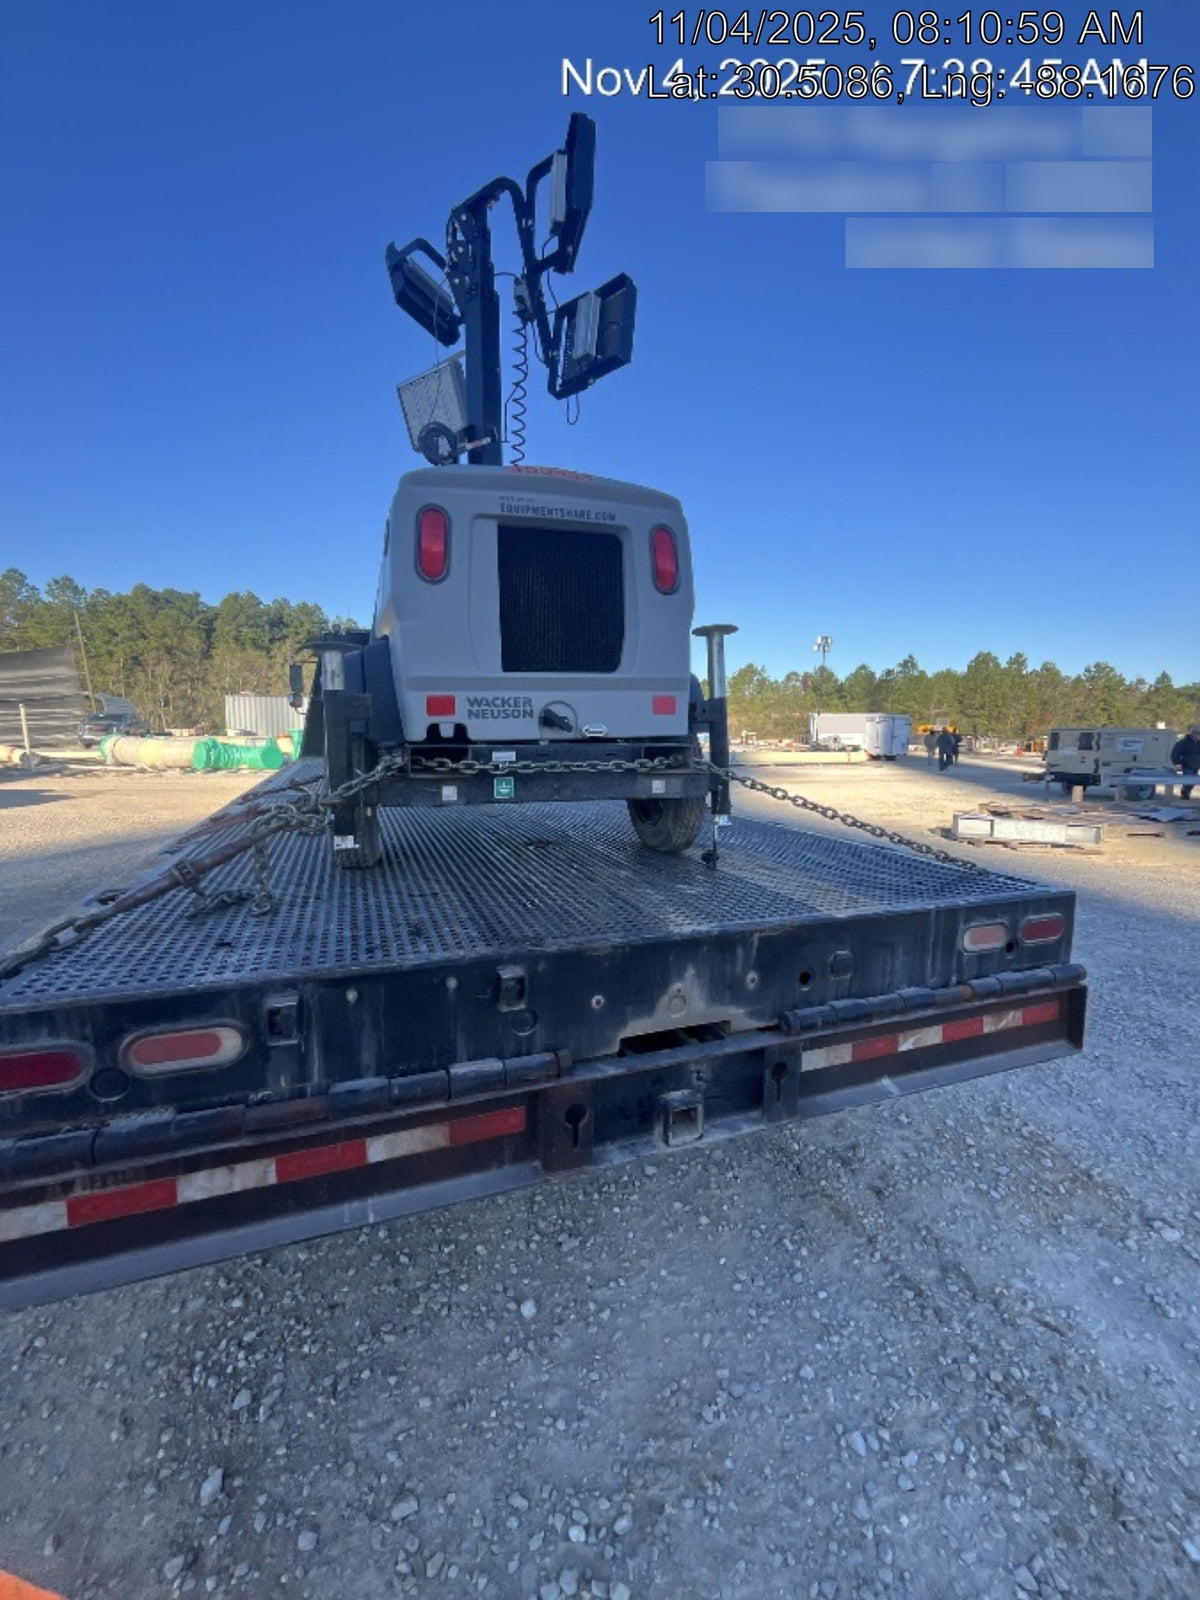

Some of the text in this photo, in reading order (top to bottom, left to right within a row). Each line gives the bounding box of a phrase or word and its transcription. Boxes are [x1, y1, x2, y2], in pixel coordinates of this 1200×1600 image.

[500, 502, 616, 522] EQUIPMENTSHARE.COM
[465, 696, 534, 708] WACKER
[467, 708, 534, 719] NEUSON
